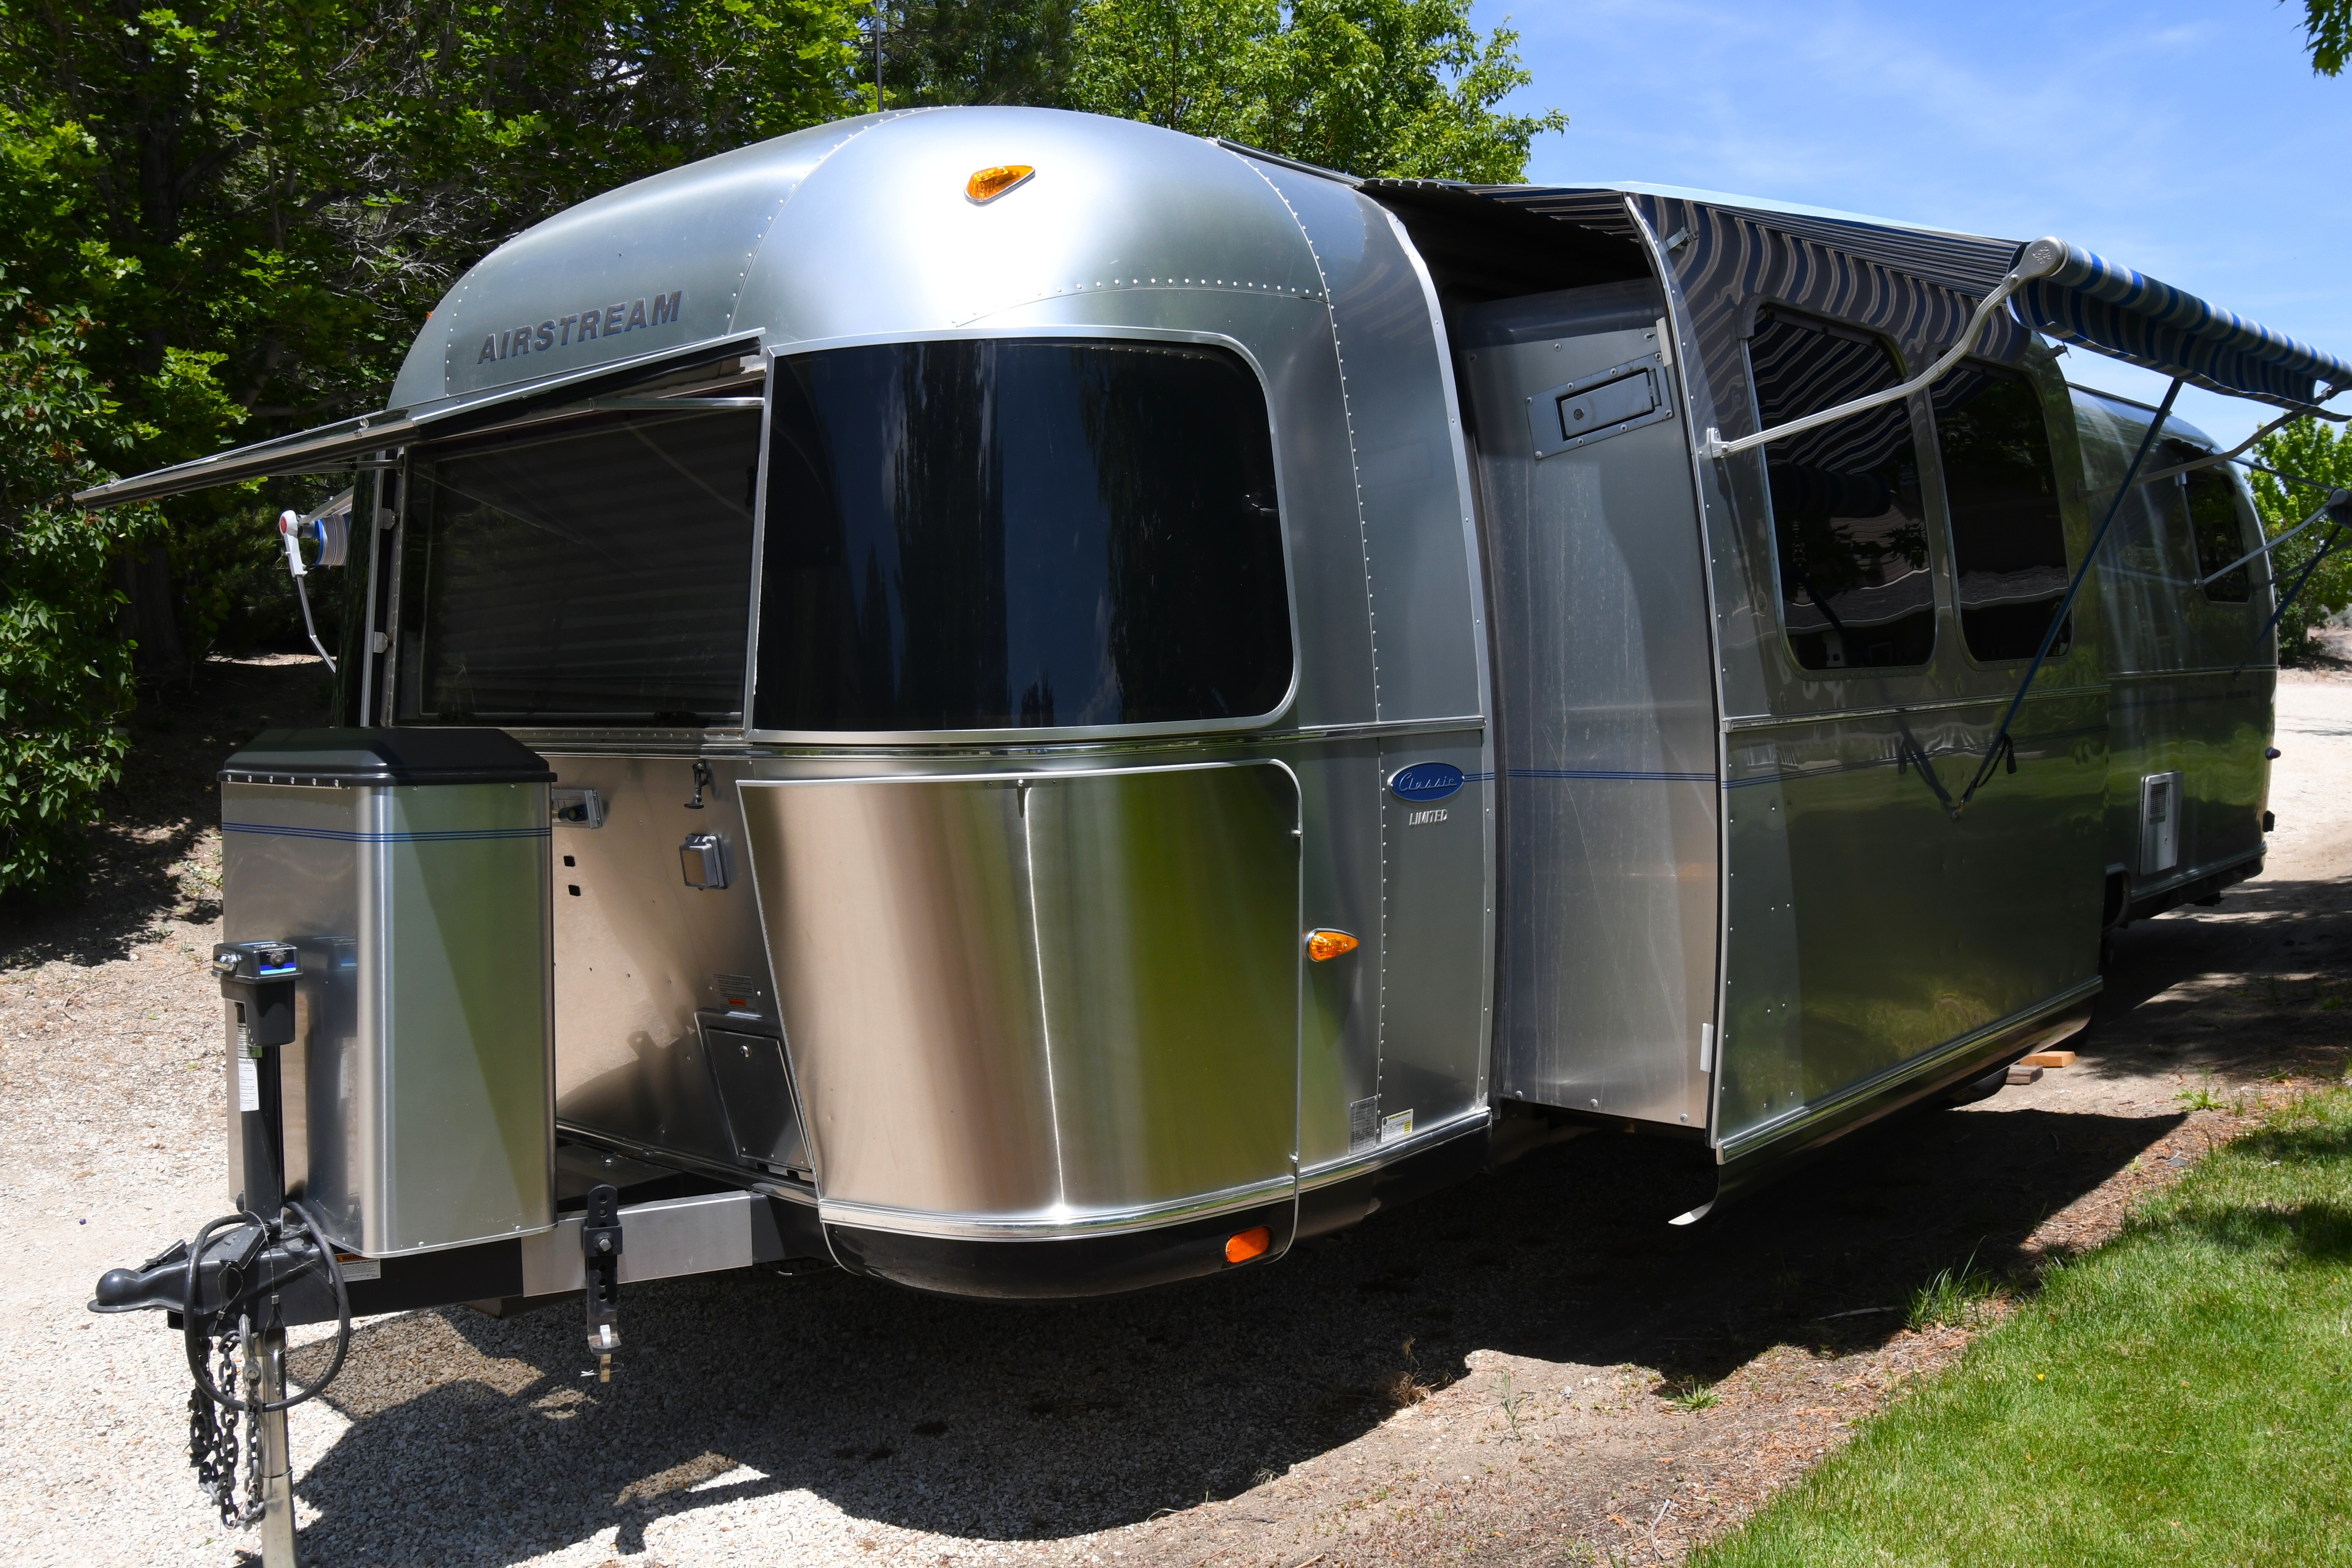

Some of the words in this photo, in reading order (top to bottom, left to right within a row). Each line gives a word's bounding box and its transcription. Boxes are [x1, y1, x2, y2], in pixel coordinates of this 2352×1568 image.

[477, 290, 683, 365] AIRSTREAM
[1399, 772, 1457, 792] Classic
[1409, 809, 1448, 826] LIMITED
